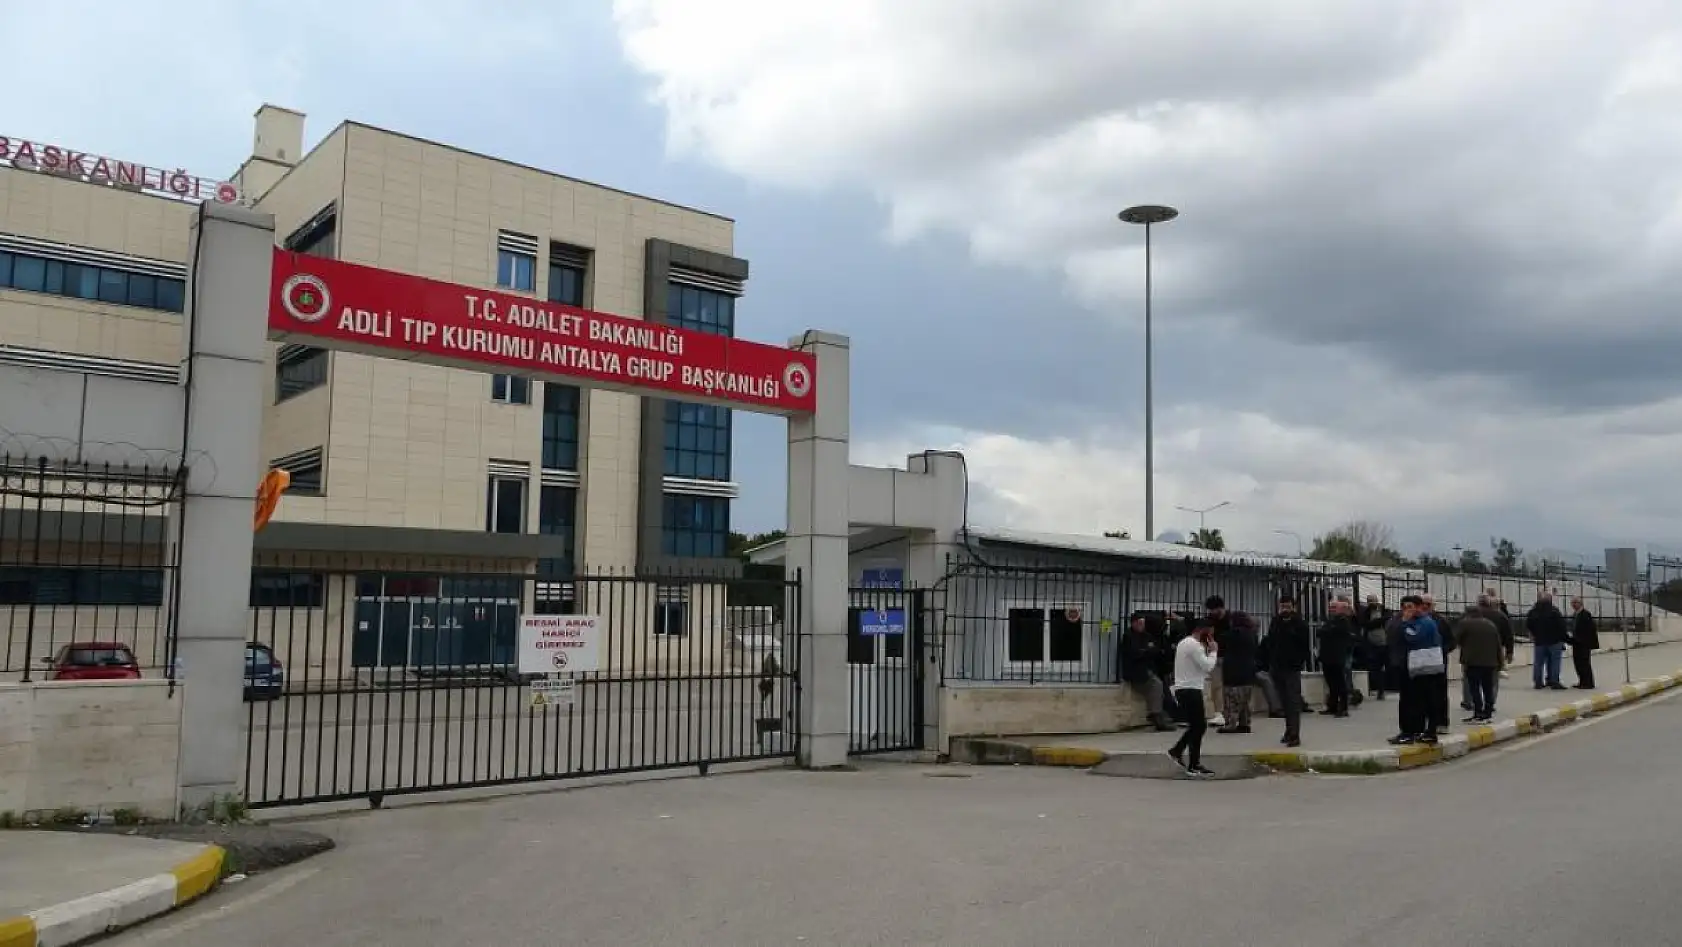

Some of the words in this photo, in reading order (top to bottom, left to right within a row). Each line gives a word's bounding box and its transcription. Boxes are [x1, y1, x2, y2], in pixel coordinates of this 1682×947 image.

[338, 307, 392, 338] ADLİ
[400, 318, 437, 345] TIP
[442, 324, 534, 360] KURUMU
[540, 341, 621, 375] ANTALYA
[626, 356, 674, 382] GRUP
[681, 365, 780, 400] BAŞKANLIĞI
[465, 295, 501, 323] T.C.
[506, 303, 583, 338] ADALET
[589, 319, 684, 357] BAKANLIĞI
